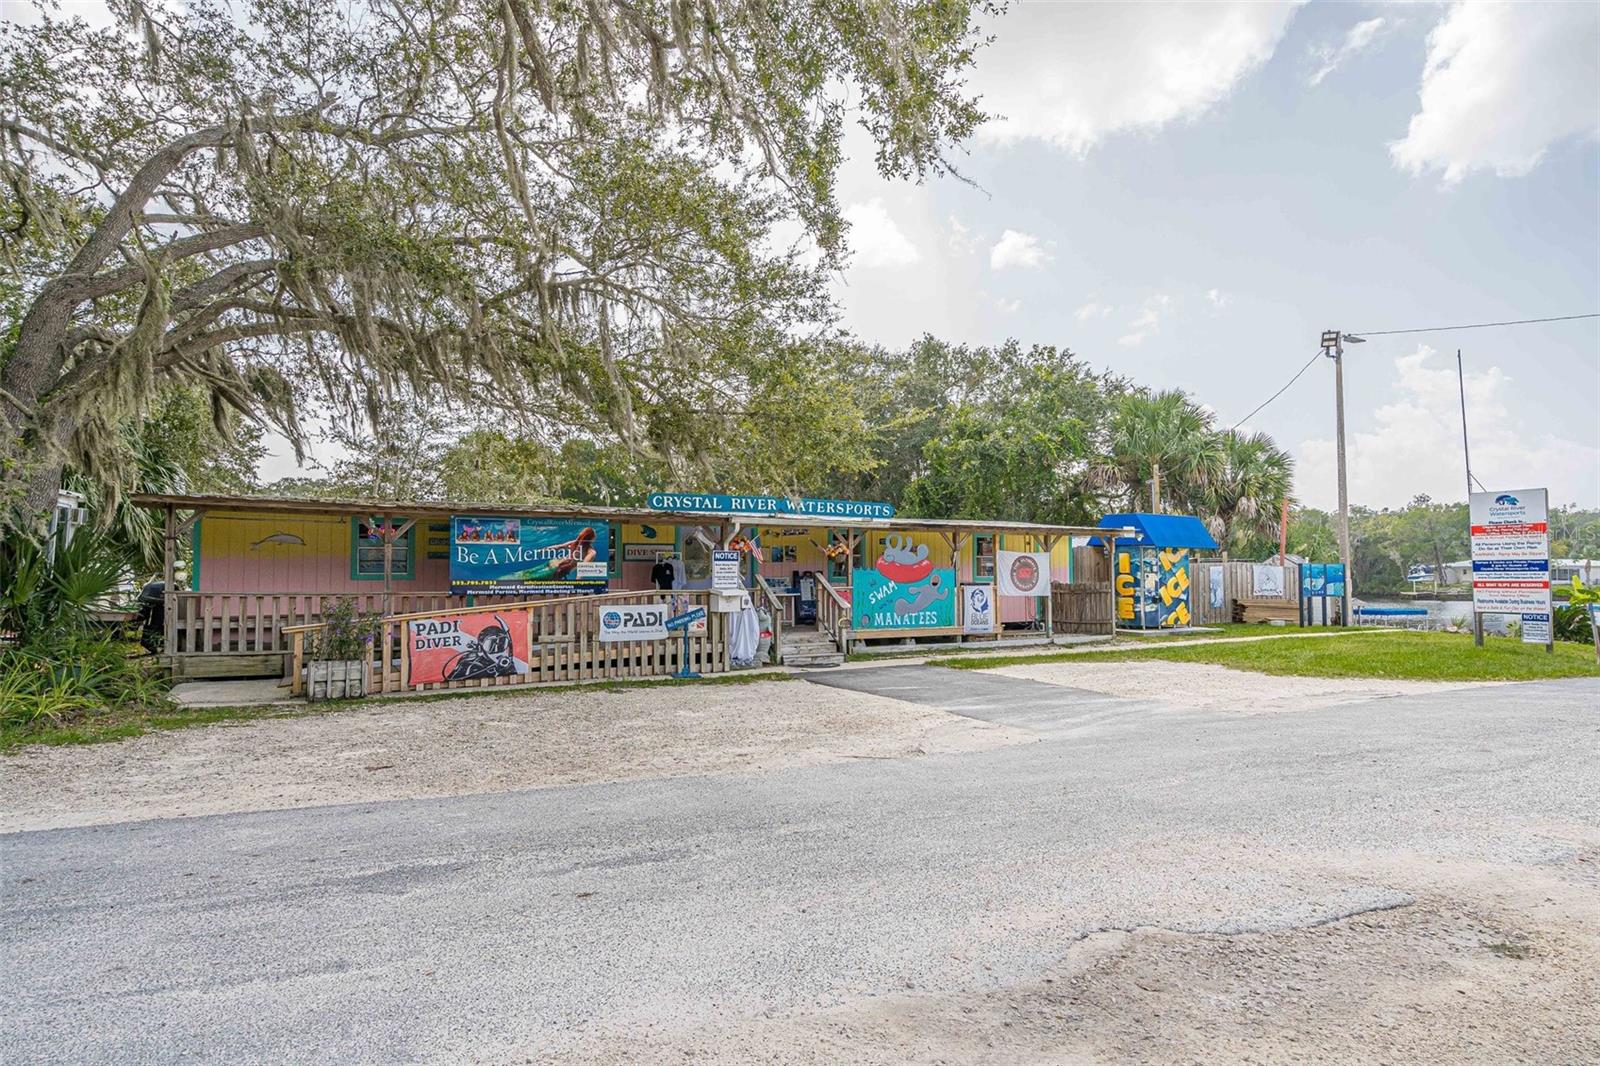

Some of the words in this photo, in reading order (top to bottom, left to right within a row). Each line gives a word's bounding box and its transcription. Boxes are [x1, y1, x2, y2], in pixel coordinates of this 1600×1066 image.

[652, 495, 722, 509] CRYSTAL
[731, 498, 777, 510] RIVER
[457, 546, 479, 564] Be
[484, 548, 499, 565] A
[505, 545, 584, 564] Mermaid
[715, 552, 737, 560] NOTICE
[869, 580, 897, 604] SWAM
[1116, 552, 1135, 619] ICE
[1159, 567, 1190, 607] ICE
[623, 611, 662, 628] PADI
[874, 611, 937, 626] MANATEES
[415, 620, 460, 636] PADI
[415, 636, 462, 650] DIVER
